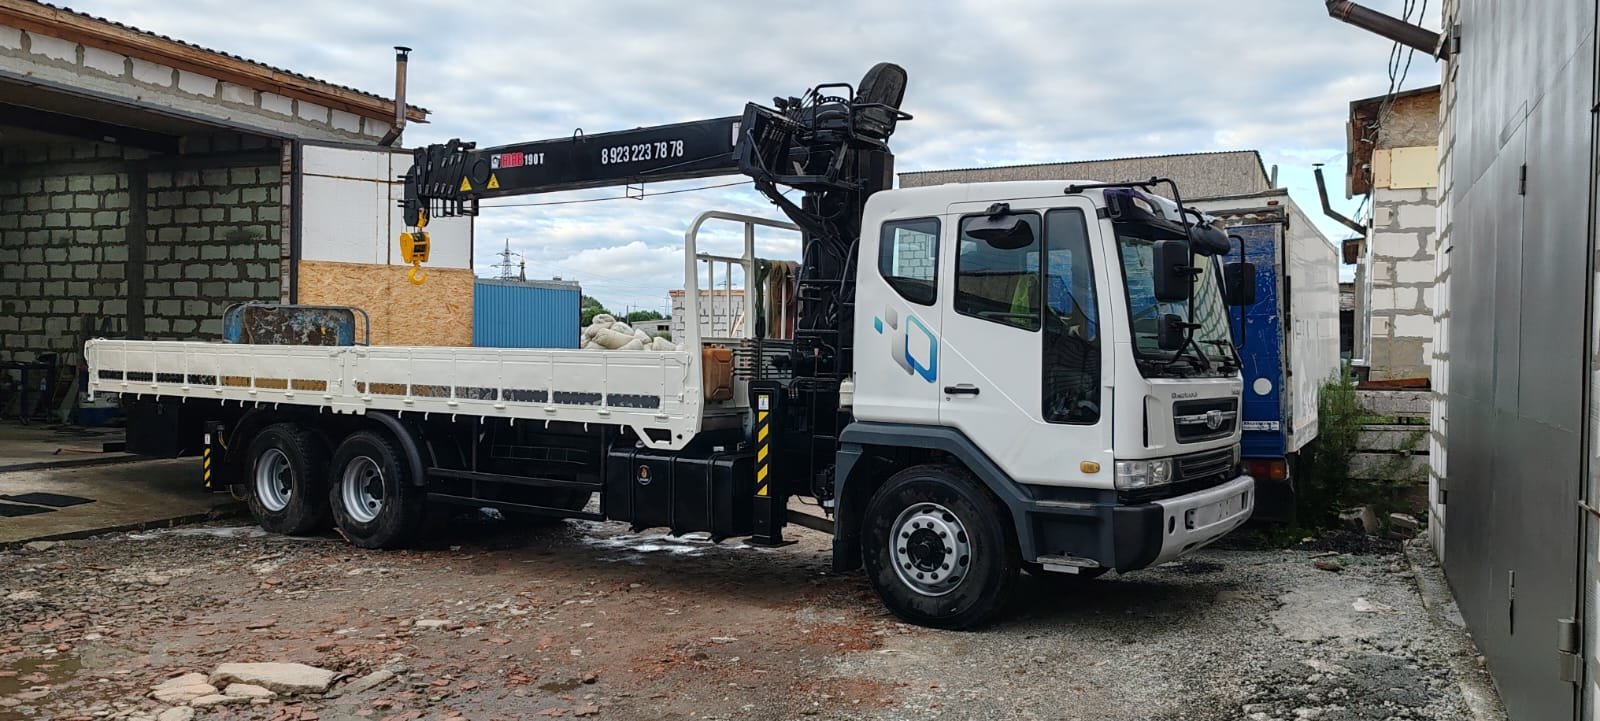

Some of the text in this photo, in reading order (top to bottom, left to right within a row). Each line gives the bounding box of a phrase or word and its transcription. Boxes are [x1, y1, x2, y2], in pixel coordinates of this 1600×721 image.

[601, 139, 684, 165] 8 923 223 78 78
